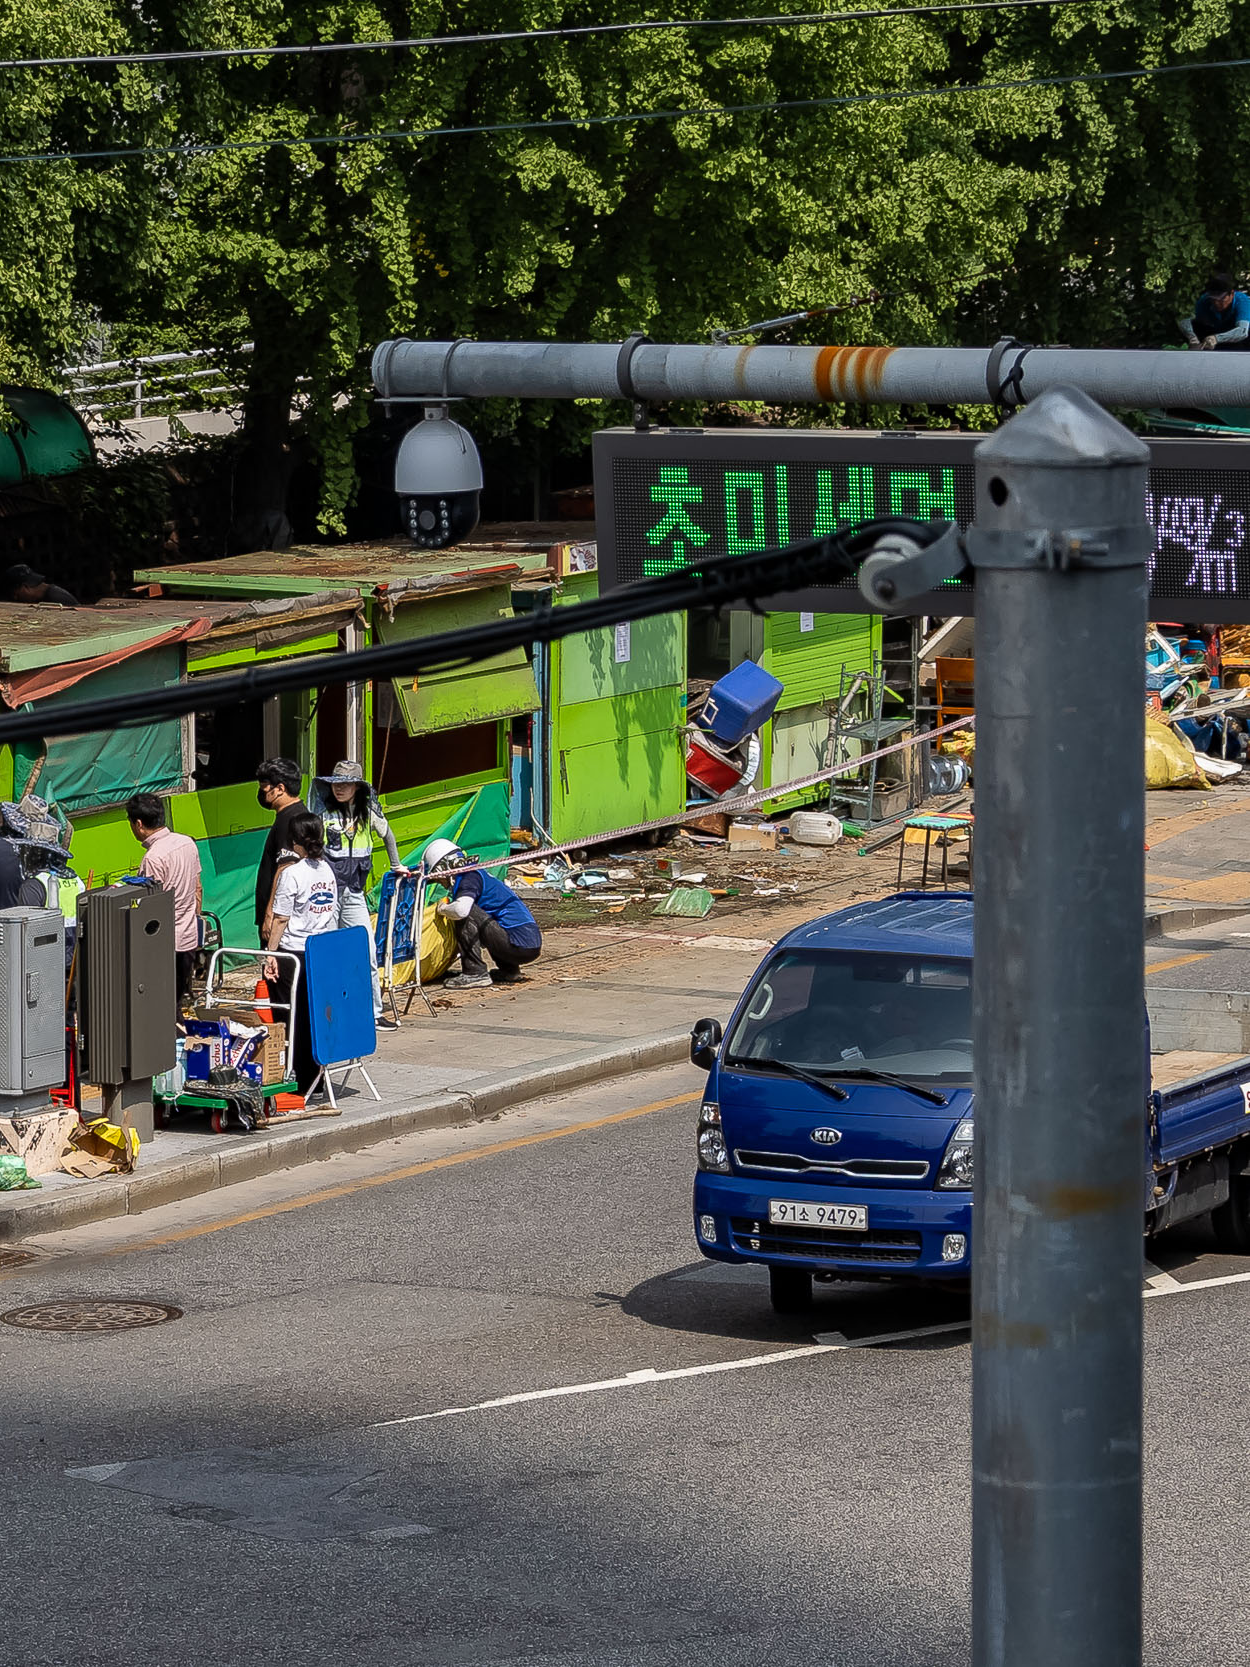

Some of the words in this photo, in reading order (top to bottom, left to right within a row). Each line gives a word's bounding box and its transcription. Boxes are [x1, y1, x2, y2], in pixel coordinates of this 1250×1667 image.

[59, 879, 78, 889] 진구
[814, 1130, 836, 1142] KIA
[778, 1204, 809, 1222] 91소
[816, 1207, 858, 1225] 9479
